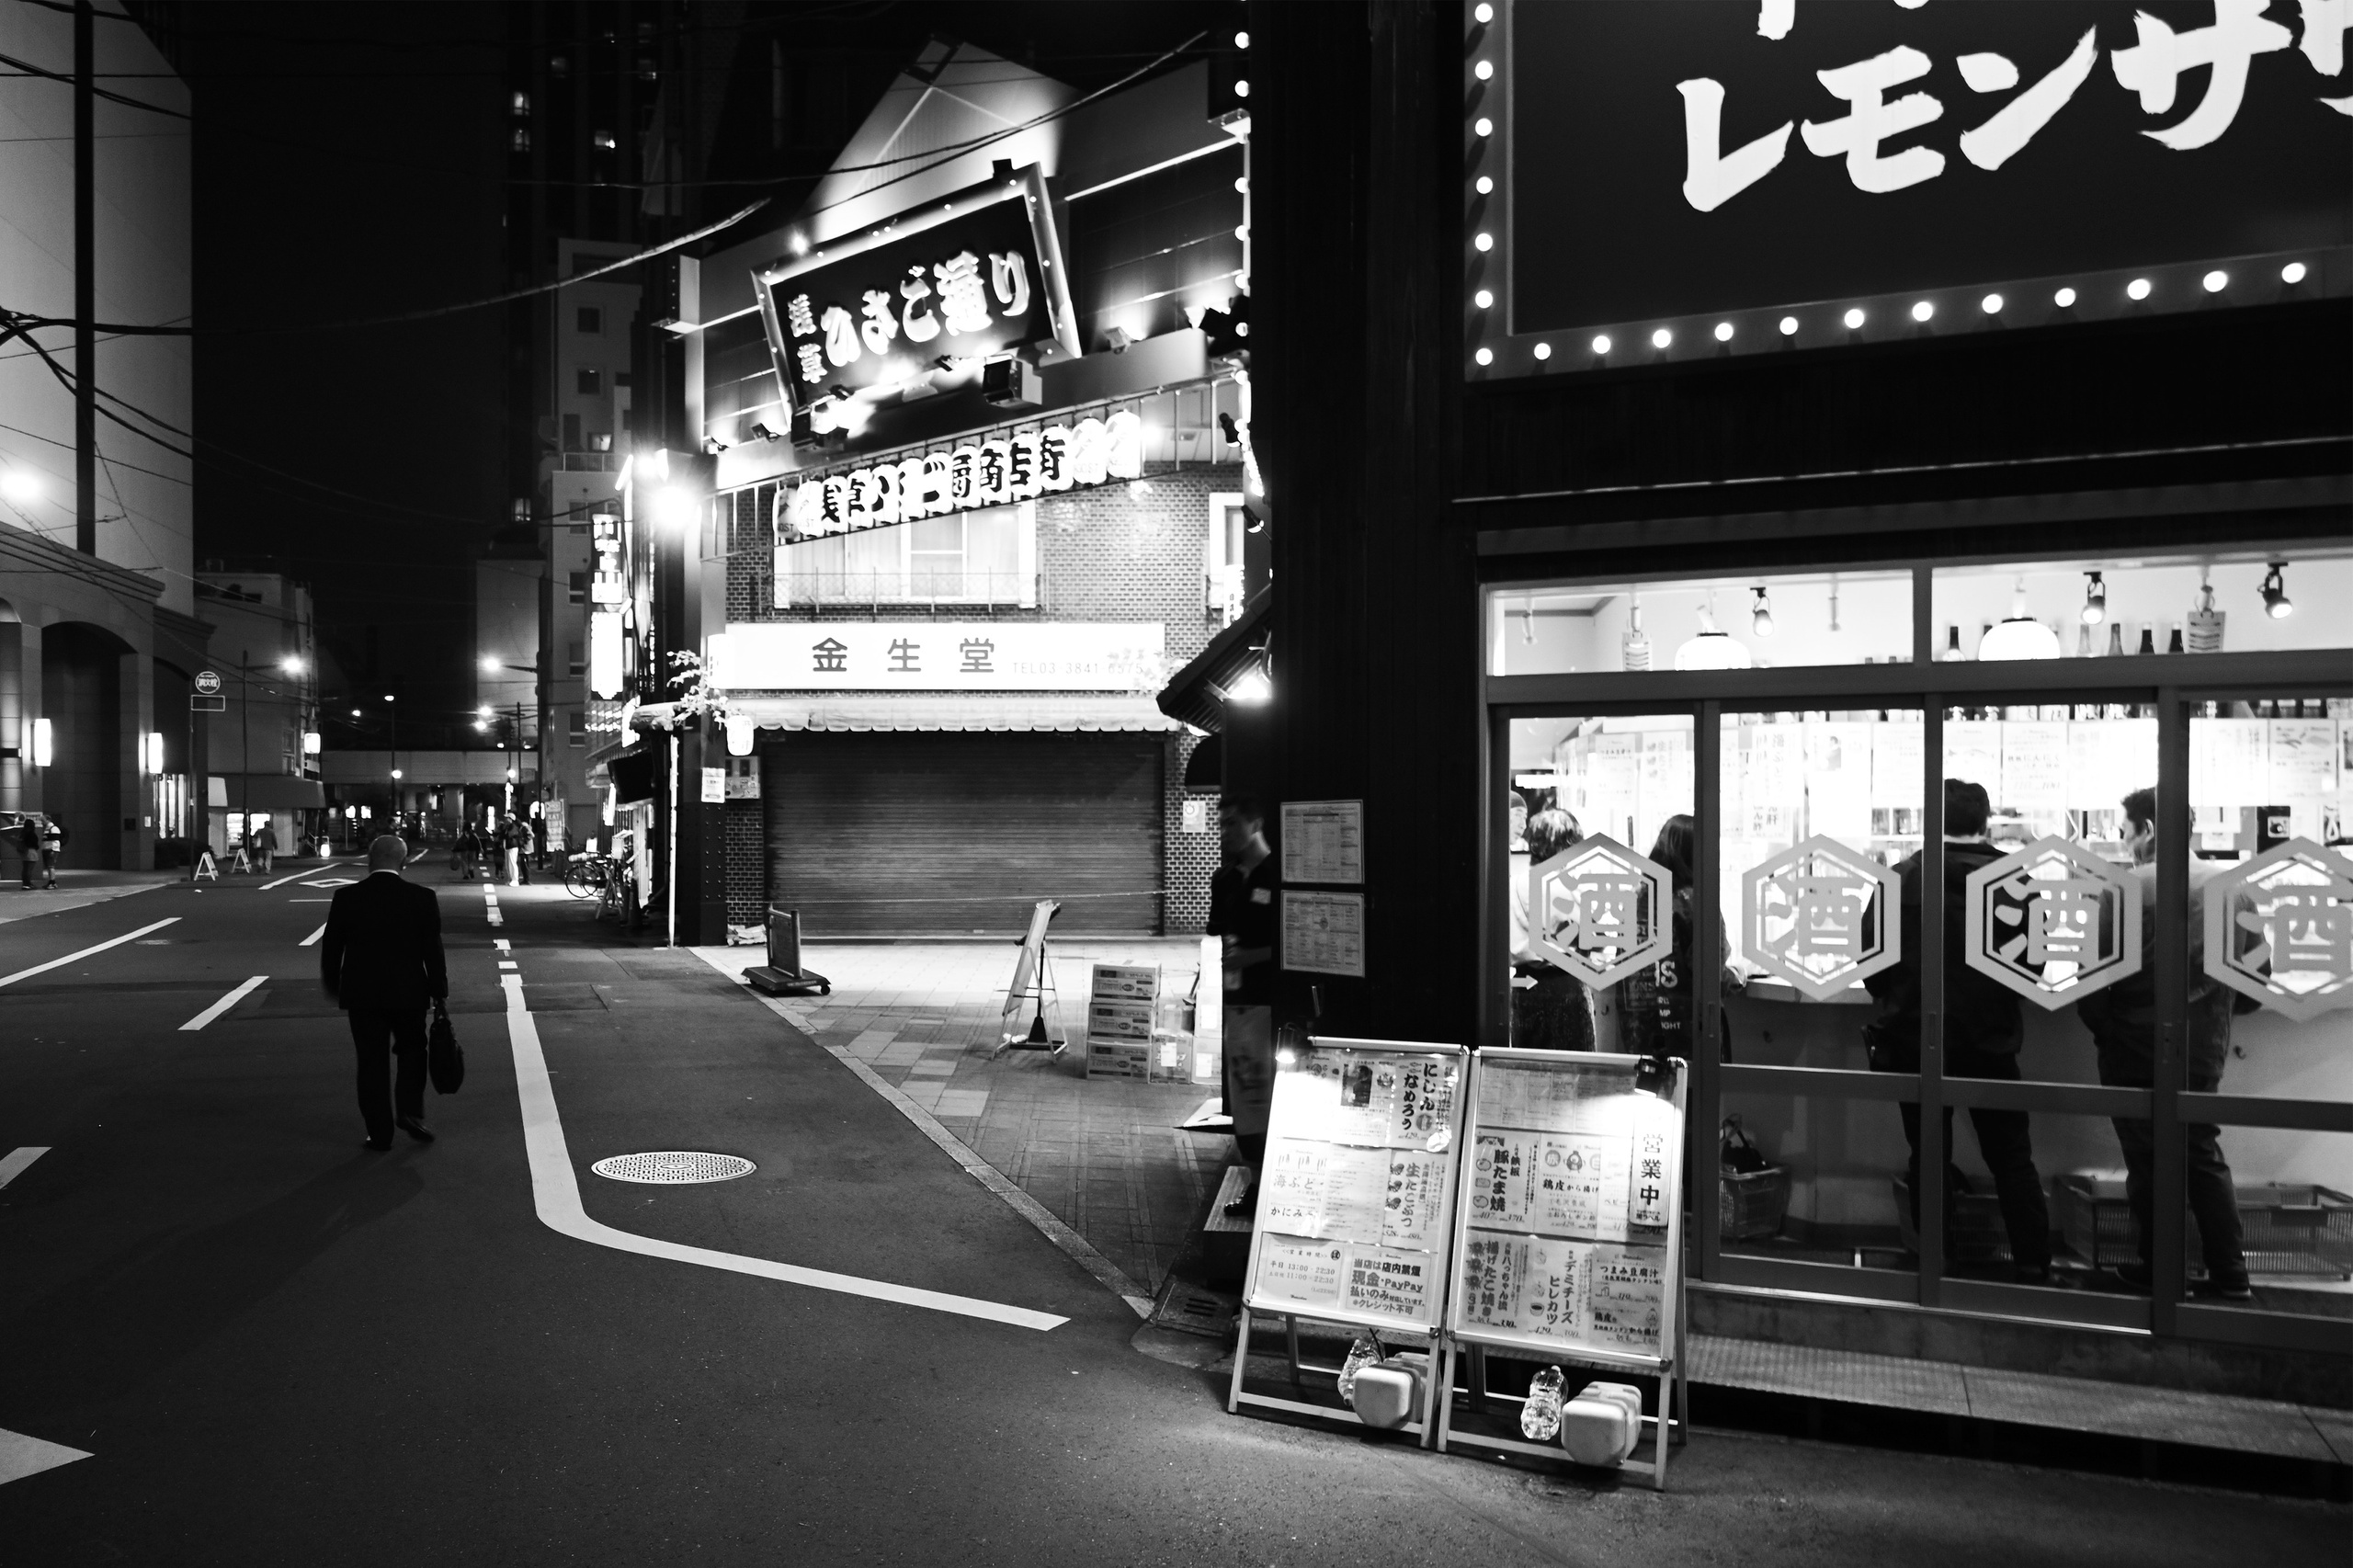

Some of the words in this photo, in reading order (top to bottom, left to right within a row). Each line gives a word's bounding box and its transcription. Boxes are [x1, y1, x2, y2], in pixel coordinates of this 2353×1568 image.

[812, 637, 995, 674] 金生堂
[1401, 1073, 1419, 1131] なめろう
[1273, 1173, 1324, 1191] 海ぶど
[1490, 1149, 1509, 1212] 豚たま焼
[1640, 1133, 1663, 1206] 営業中
[1353, 1257, 1422, 1278] 当店は店内禁煙
